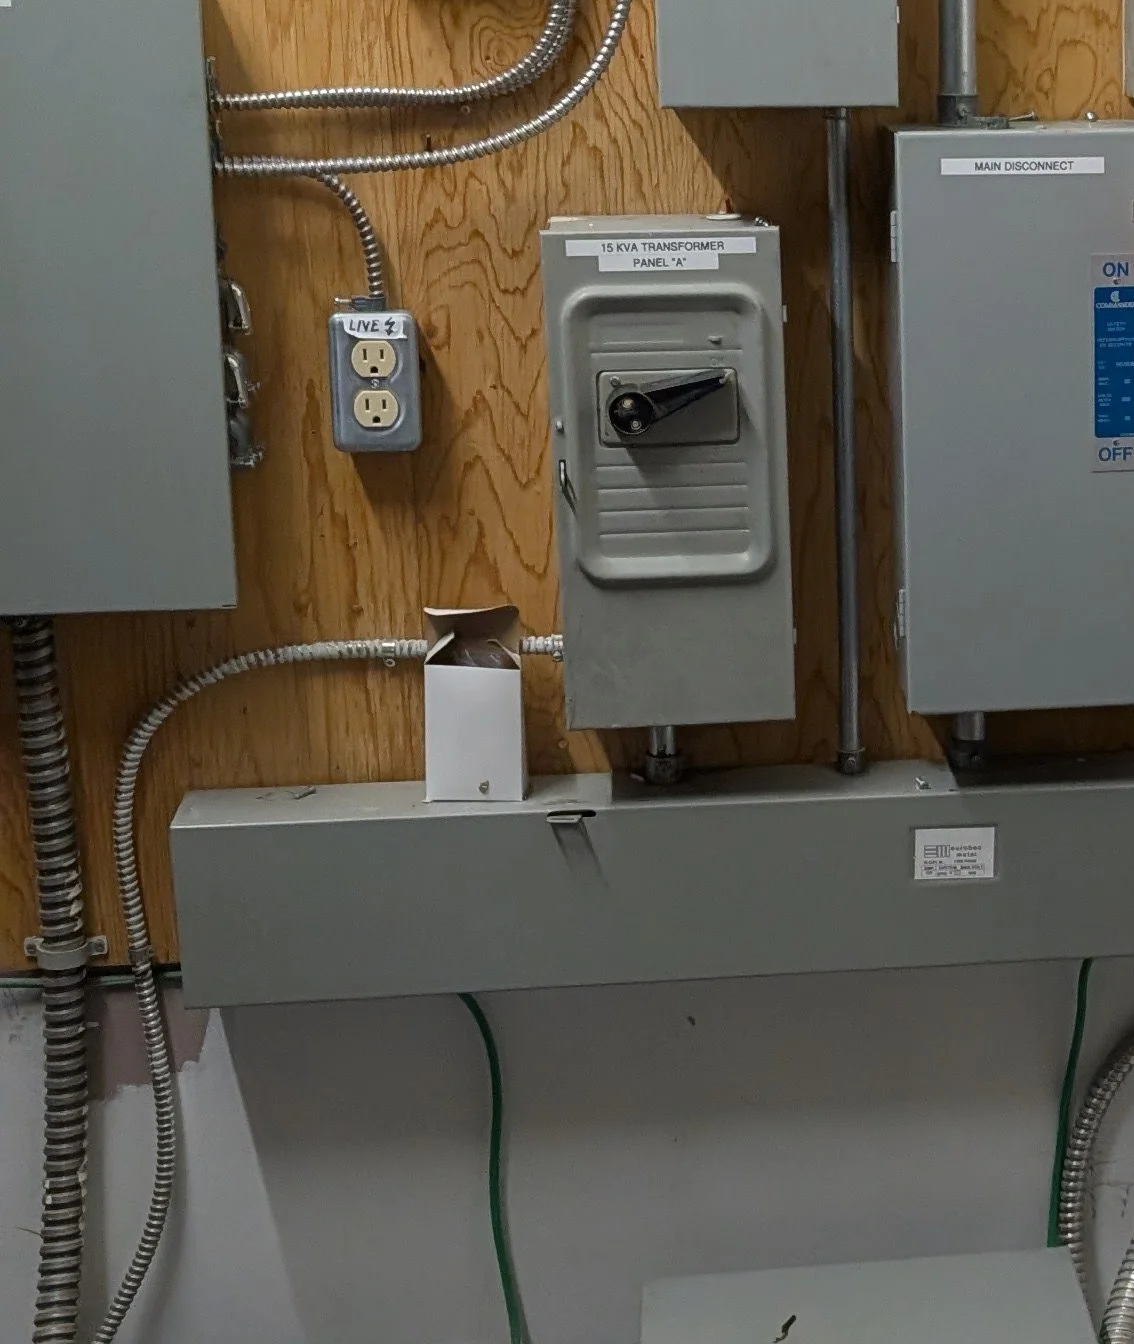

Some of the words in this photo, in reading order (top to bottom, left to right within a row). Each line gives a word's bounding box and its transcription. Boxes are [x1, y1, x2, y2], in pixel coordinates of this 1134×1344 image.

[974, 161, 1001, 172] MAIN
[1004, 160, 1075, 172] DISCONNECT
[600, 242, 614, 253] 15
[616, 241, 639, 253] KVA
[640, 240, 725, 252] TRANSFORMER
[632, 257, 669, 268] PANEL
[671, 257, 688, 268] "A"
[1101, 262, 1130, 278] ON
[349, 319, 380, 332] LIVE
[1097, 446, 1134, 462] OFF
